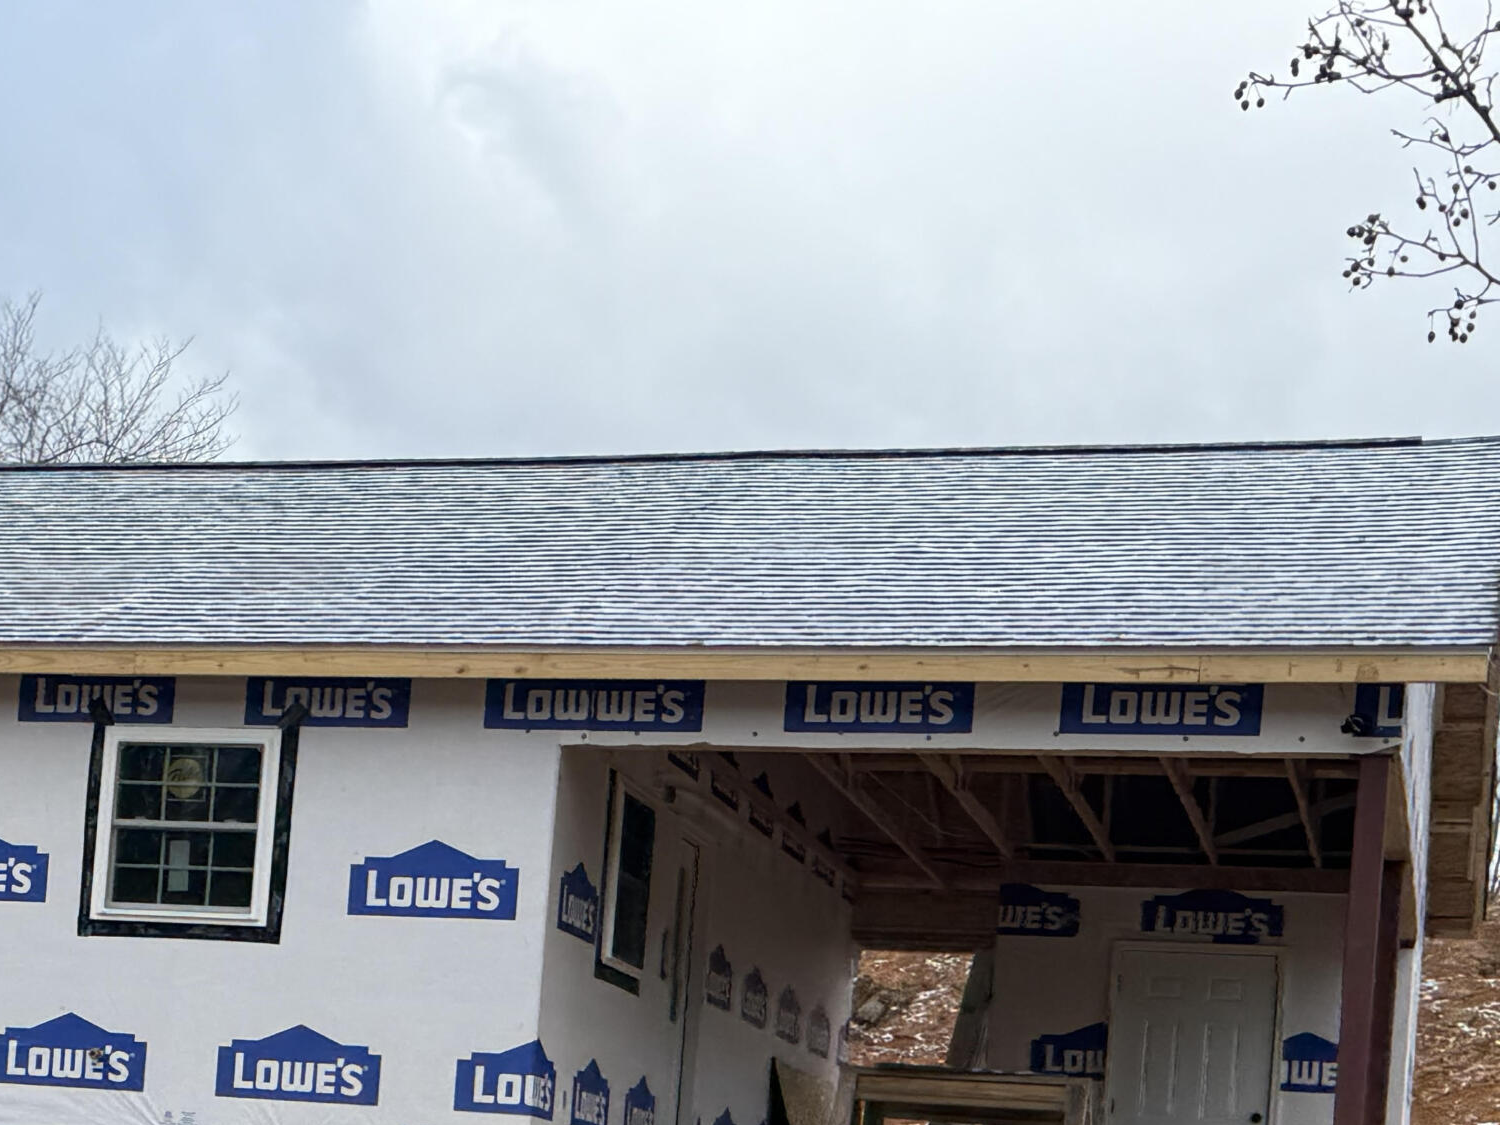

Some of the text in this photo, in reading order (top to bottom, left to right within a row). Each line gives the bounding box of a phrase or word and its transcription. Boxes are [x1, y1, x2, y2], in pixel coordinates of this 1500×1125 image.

[804, 685, 956, 725] LOWE'S
[1081, 685, 1241, 727] LOWE'S
[366, 871, 501, 912] LOWE'S
[6, 1040, 130, 1083] LOWE'S
[233, 1052, 364, 1097] LOWE'S
